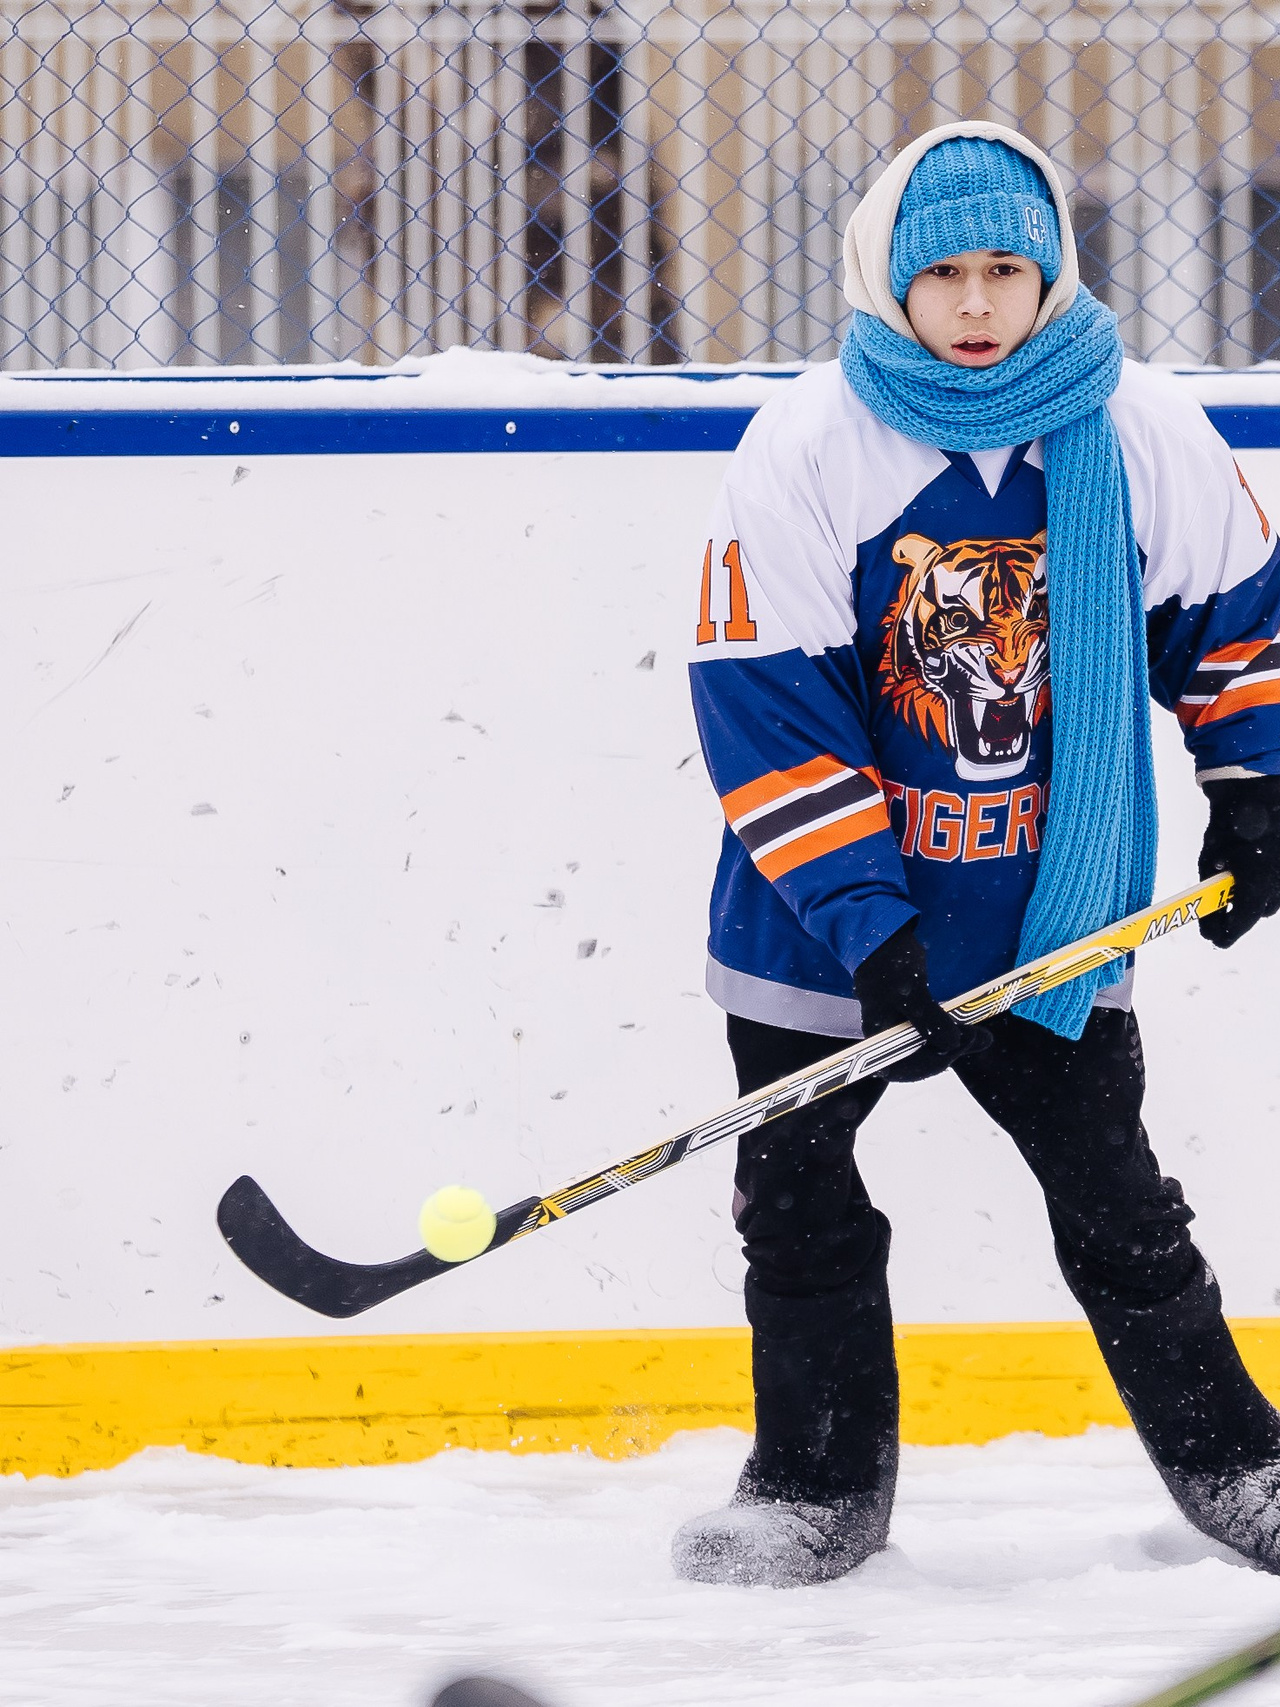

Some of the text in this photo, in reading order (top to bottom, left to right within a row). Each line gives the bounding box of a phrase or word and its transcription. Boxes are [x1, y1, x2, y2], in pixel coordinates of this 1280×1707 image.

[695, 538, 758, 646] 11
[882, 779, 1051, 863] IGER
[1141, 896, 1203, 945] MAX
